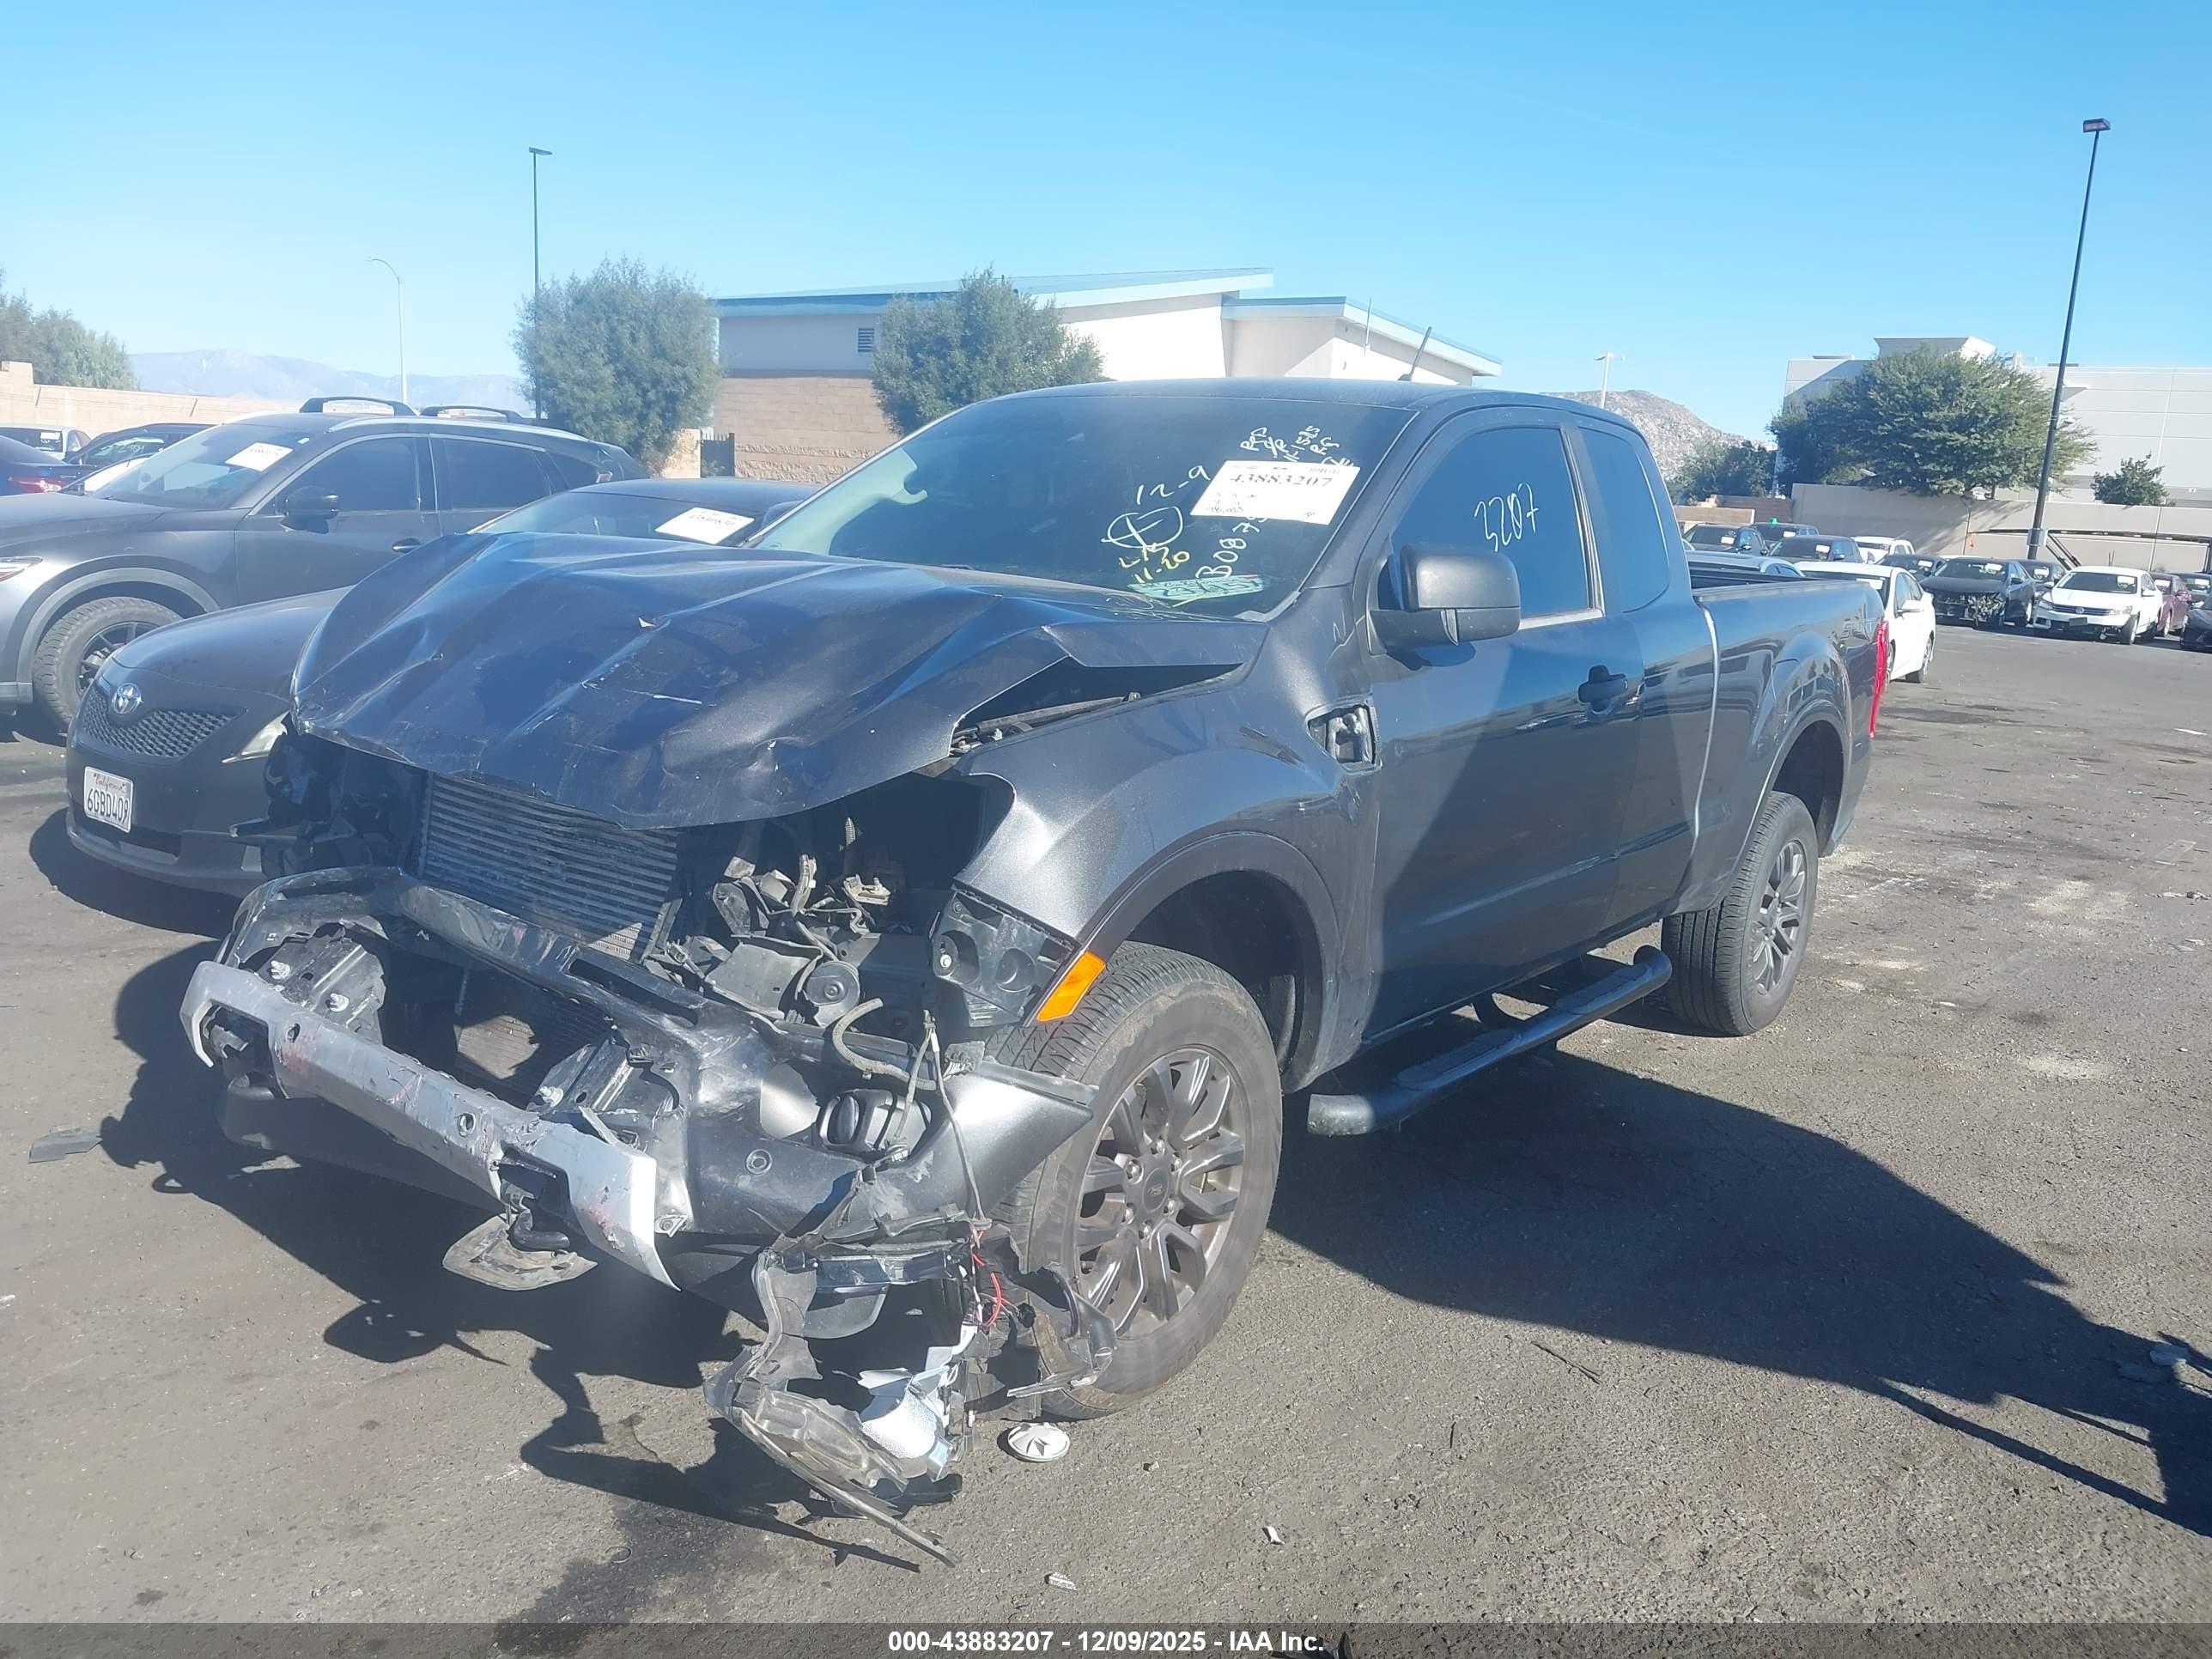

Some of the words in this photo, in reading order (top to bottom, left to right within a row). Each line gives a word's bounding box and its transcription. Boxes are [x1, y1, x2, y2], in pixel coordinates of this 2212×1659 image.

[1230, 473, 1334, 487] 43883207
[1474, 481, 1540, 552] 3207
[87, 787, 129, 823] 6GBD409
